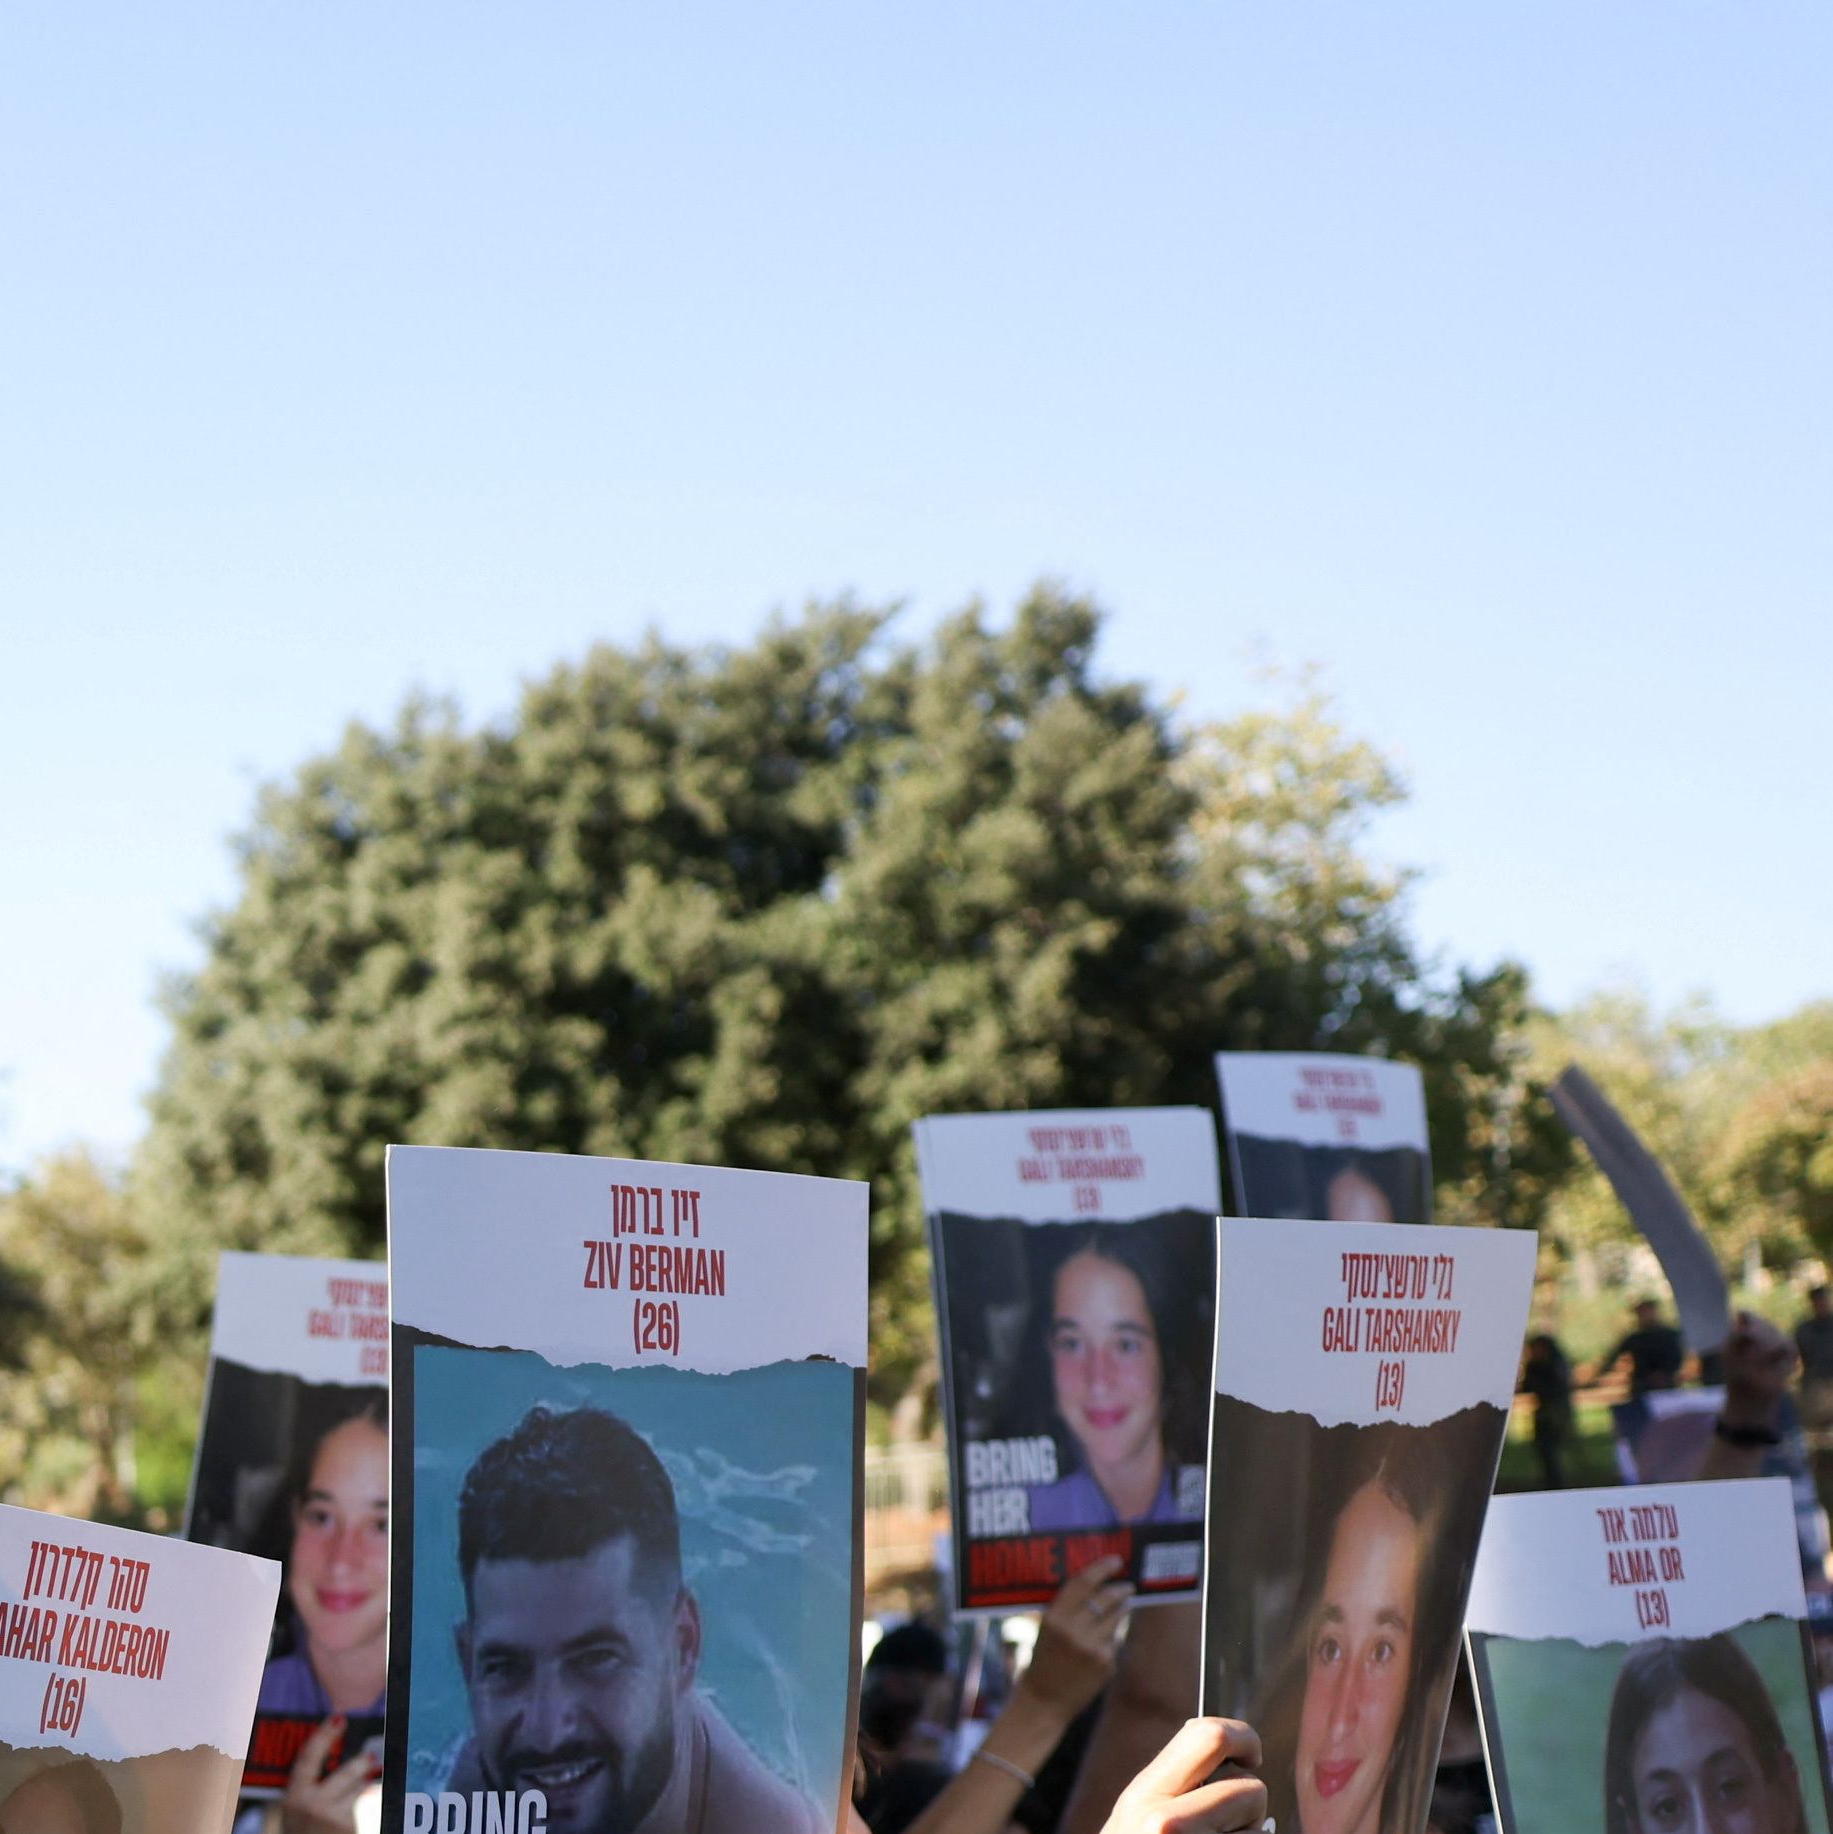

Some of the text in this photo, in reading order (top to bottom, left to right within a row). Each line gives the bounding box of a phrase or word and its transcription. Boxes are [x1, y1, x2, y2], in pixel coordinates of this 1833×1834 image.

[610, 1184, 701, 1238] זיו ברמן
[583, 1240, 726, 1298] ZIV BERMAN
[1433, 1253, 1454, 1300] גלי
[634, 1299, 680, 1356] (26)
[1323, 1307, 1461, 1353] GALI TARSHANSKY
[1375, 1359, 1405, 1412] (13)
[965, 1435, 1058, 1488] BRING
[967, 1487, 1031, 1537] HER
[22, 1541, 150, 1614] סהר קלדרון
[1607, 1547, 1685, 1586] ALMA OR
[1635, 1589, 1671, 1631] (13)
[56, 1614, 170, 1681] KALDERON
[39, 1672, 87, 1737] (16)
